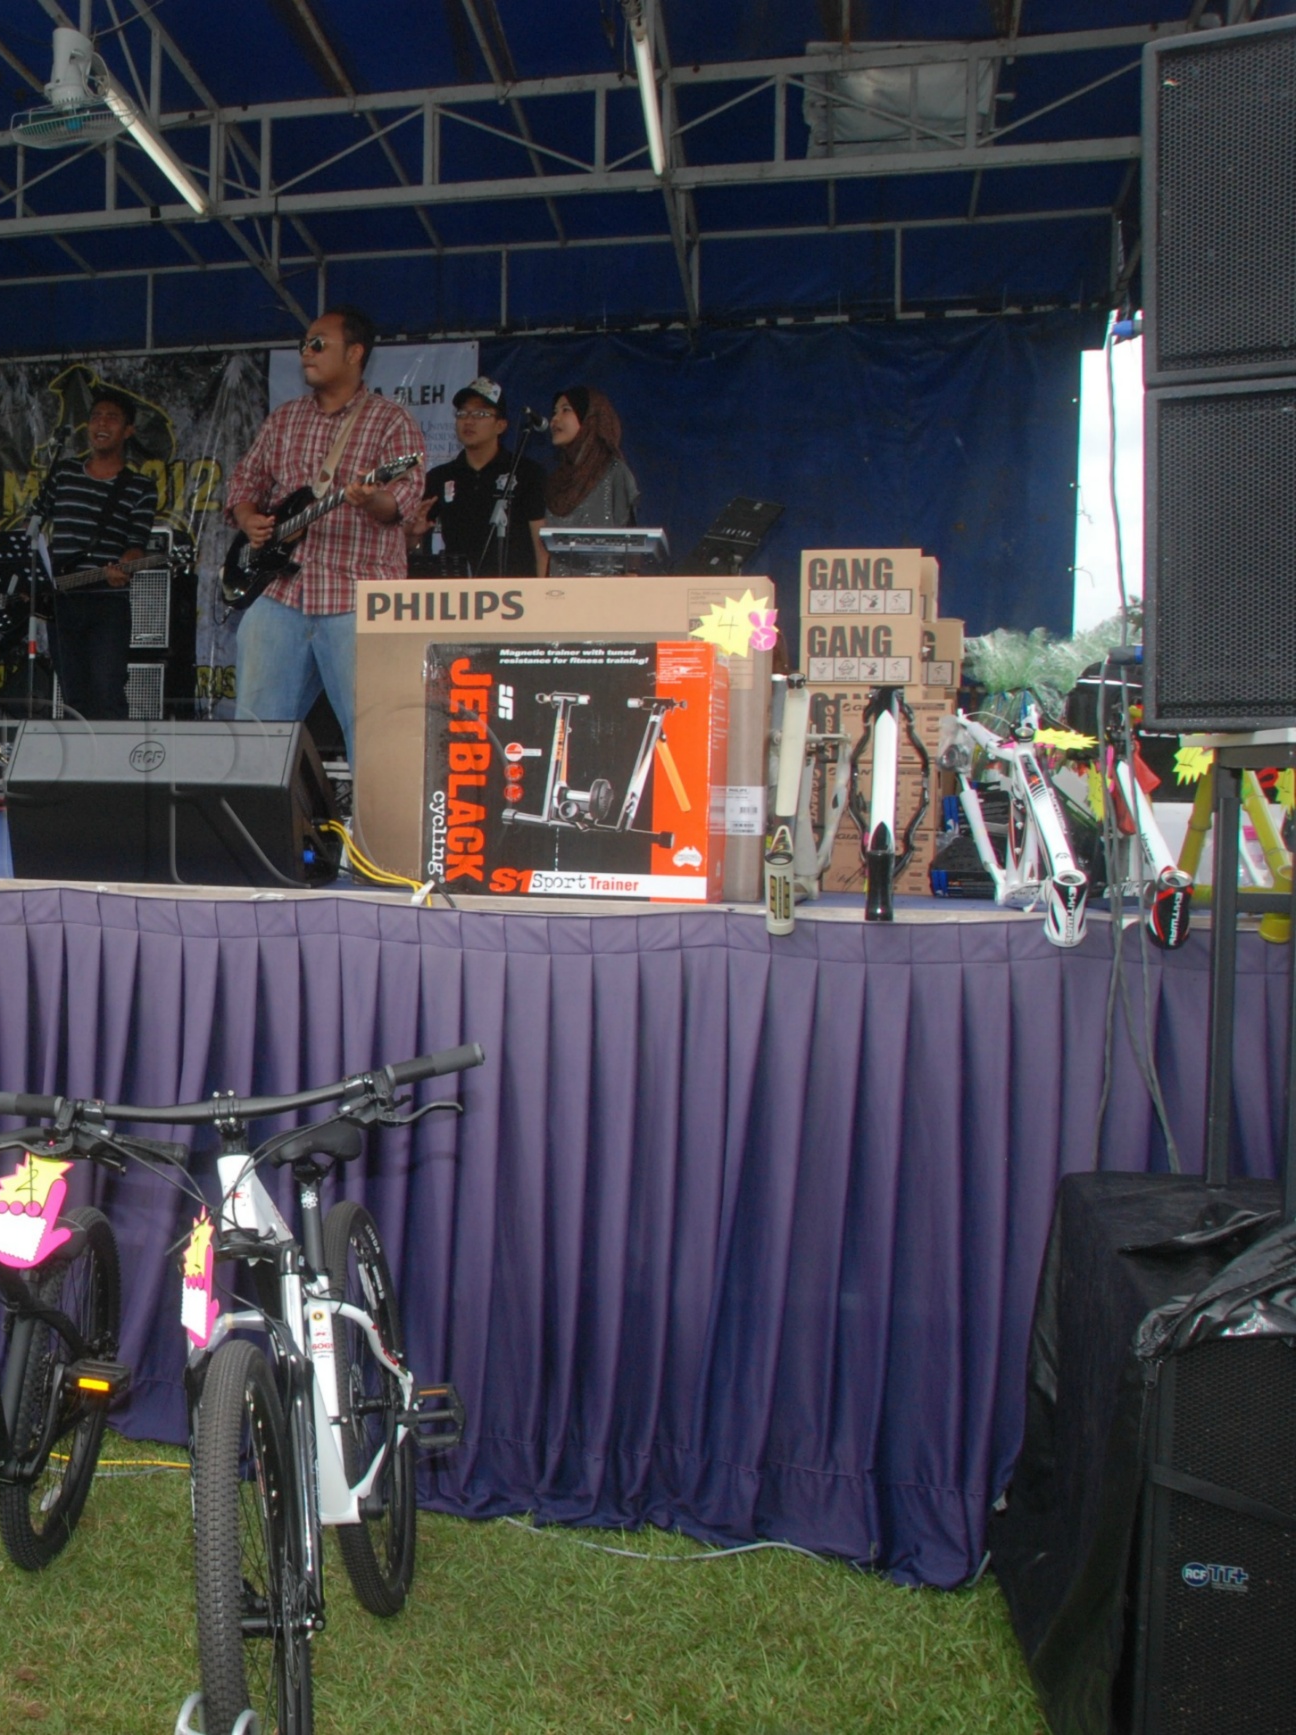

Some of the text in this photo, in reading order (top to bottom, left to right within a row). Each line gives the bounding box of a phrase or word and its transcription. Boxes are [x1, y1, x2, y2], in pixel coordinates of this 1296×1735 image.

[807, 556, 894, 591] GANG
[366, 590, 525, 621] PHILIPS
[499, 649, 545, 657] Magnetic
[806, 624, 893, 658] GANG
[605, 657, 649, 665] training!
[132, 750, 163, 764] RCF
[446, 657, 492, 882] JETBLACK
[427, 790, 448, 876] cycling
[489, 867, 639, 893] S1 Sport Trainer
[15, 1168, 39, 1192] 2
[1185, 1567, 1207, 1581] RCF
